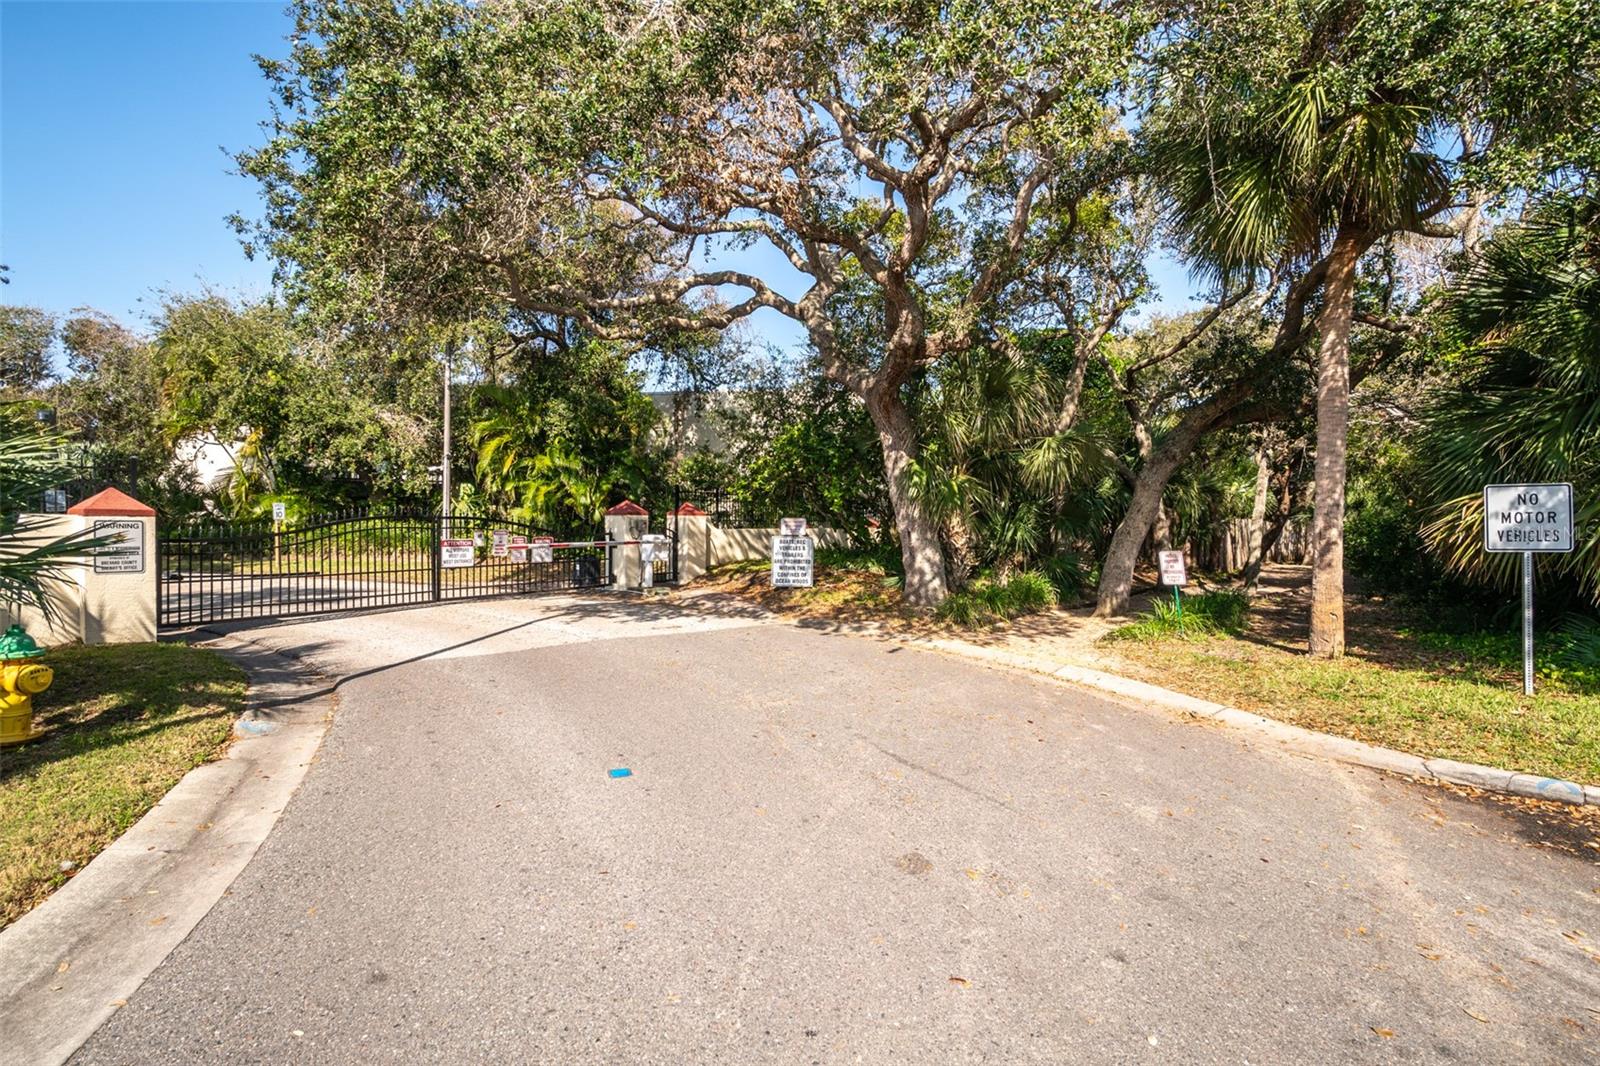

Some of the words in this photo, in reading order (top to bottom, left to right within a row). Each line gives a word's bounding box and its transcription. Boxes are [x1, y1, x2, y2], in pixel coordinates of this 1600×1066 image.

[1517, 493, 1539, 506] NO
[1501, 511, 1557, 524] MOTOR
[1497, 530, 1560, 543] VEHICLES
